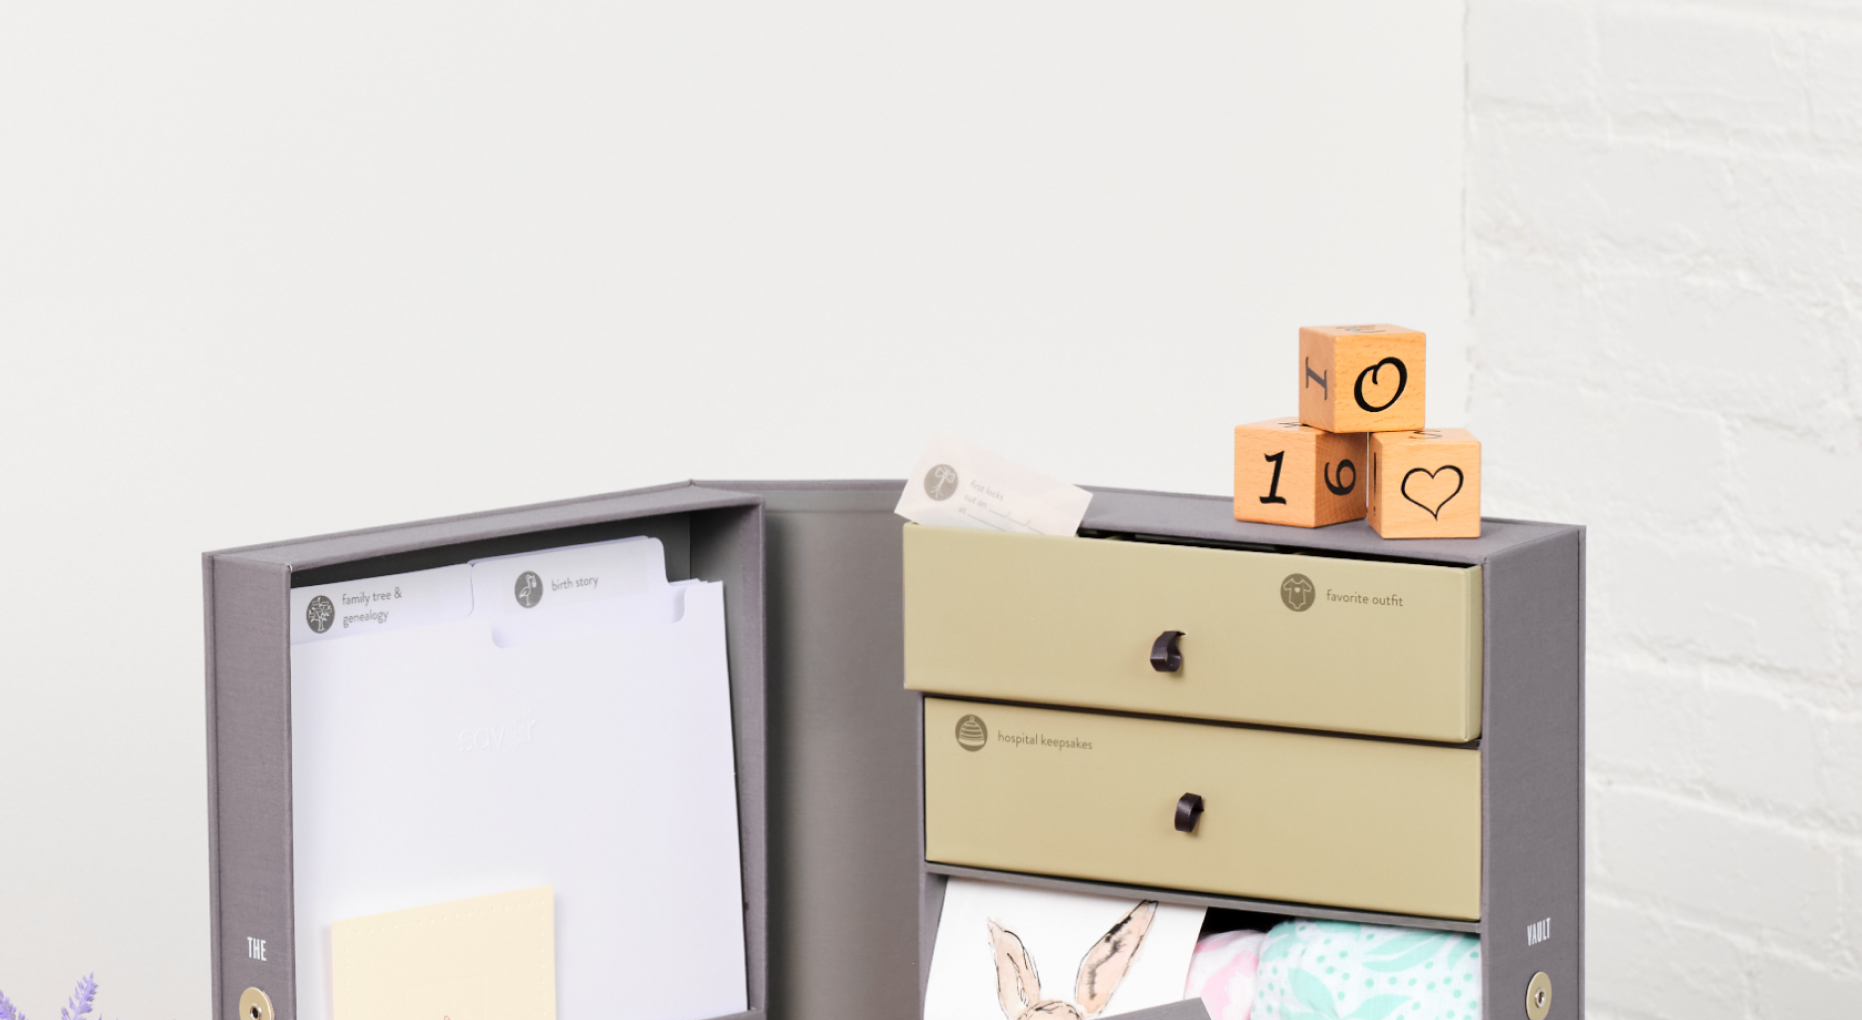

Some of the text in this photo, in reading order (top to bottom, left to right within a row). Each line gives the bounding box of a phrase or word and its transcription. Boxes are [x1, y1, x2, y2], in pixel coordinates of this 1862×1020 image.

[1353, 356, 1408, 413] O
[1258, 450, 1287, 505] 1
[964, 493, 977, 504] cut
[551, 575, 599, 591] birth story
[342, 586, 403, 606] family tree &
[1326, 588, 1404, 607] favorite outfit
[342, 608, 389, 628] genealogy
[997, 729, 1093, 751] hospital keepsakes
[1526, 916, 1551, 946] VAULT
[247, 936, 267, 961] THE
